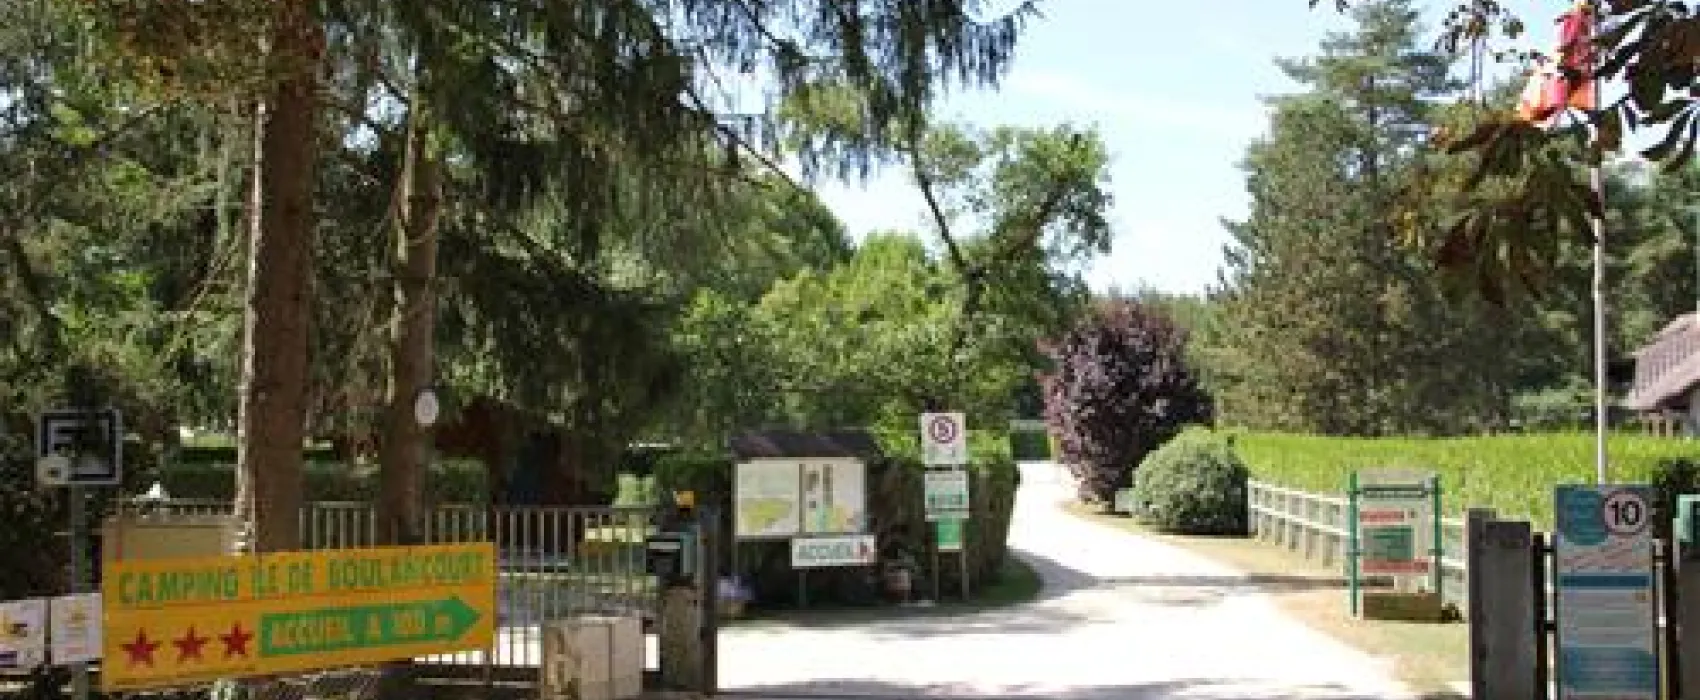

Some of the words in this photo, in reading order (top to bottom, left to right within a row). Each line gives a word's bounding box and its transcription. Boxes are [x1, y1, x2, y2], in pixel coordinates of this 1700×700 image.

[1611, 500, 1640, 525] 10
[118, 567, 239, 604] CAMPING
[328, 551, 484, 588] BOULANCOURT
[270, 614, 355, 647] ACCUEIL
